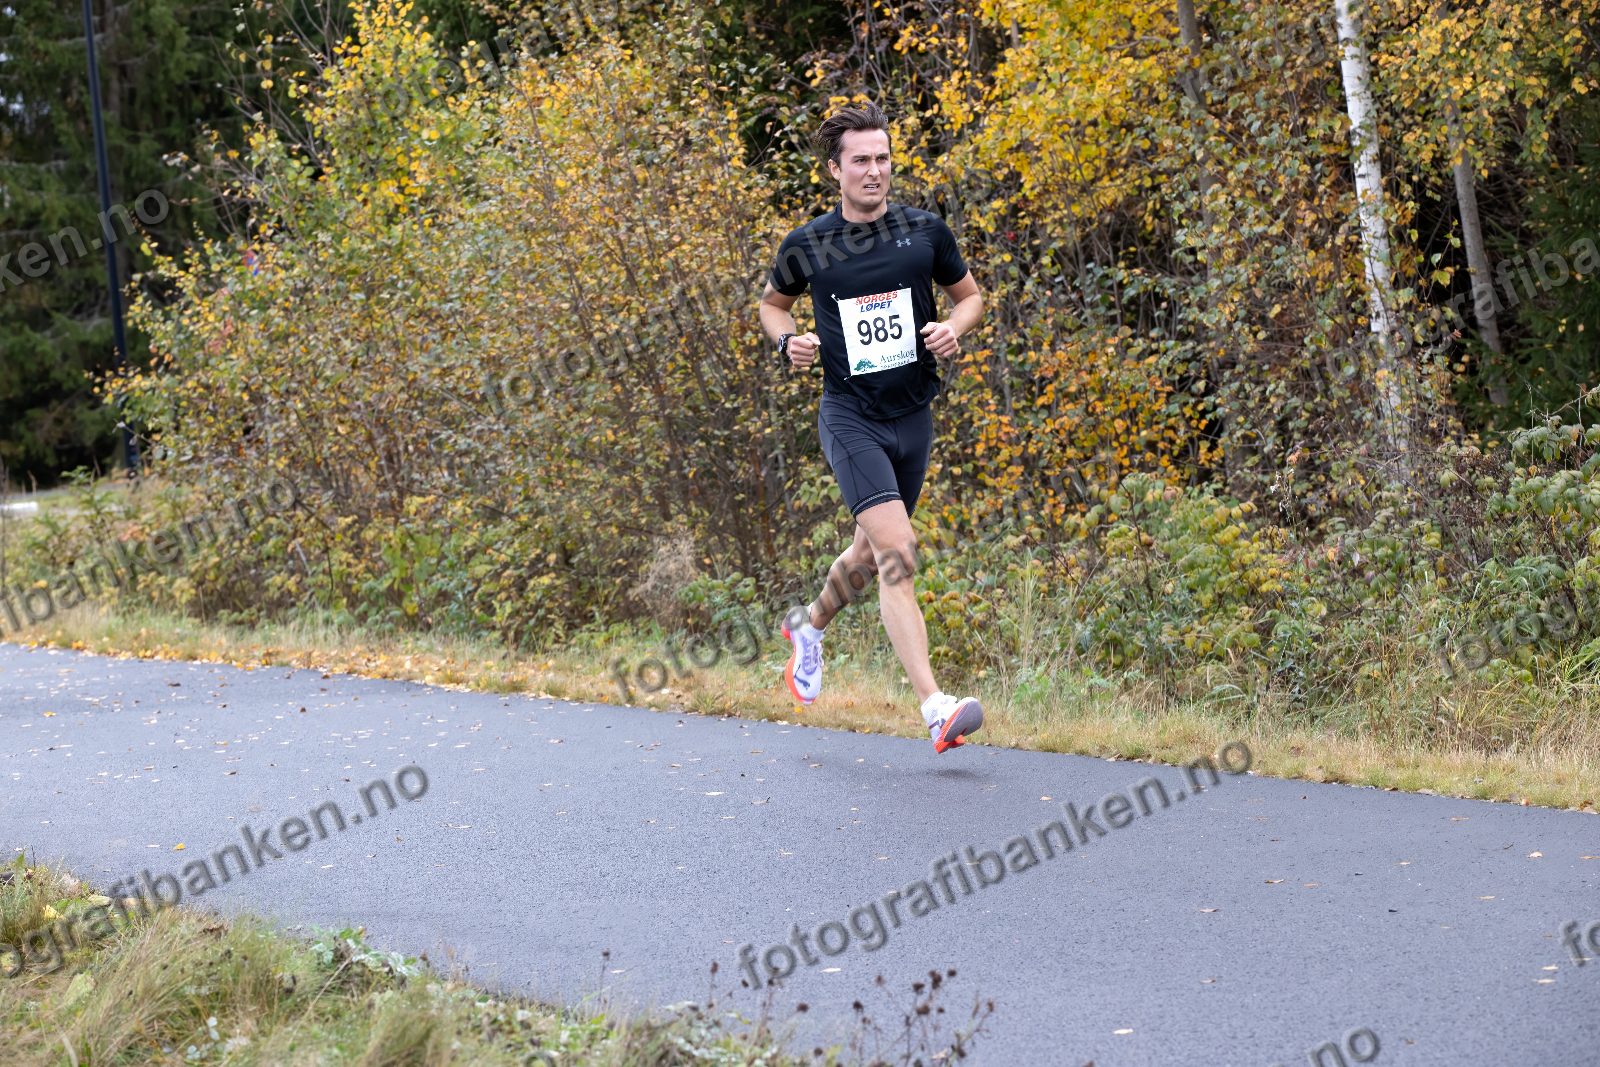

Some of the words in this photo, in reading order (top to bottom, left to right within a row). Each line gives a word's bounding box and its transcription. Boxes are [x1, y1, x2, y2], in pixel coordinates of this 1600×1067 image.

[856, 291, 898, 304] NORGES
[860, 300, 893, 312] LØPET
[857, 314, 903, 345] 985
[880, 350, 915, 364] Aurskog
